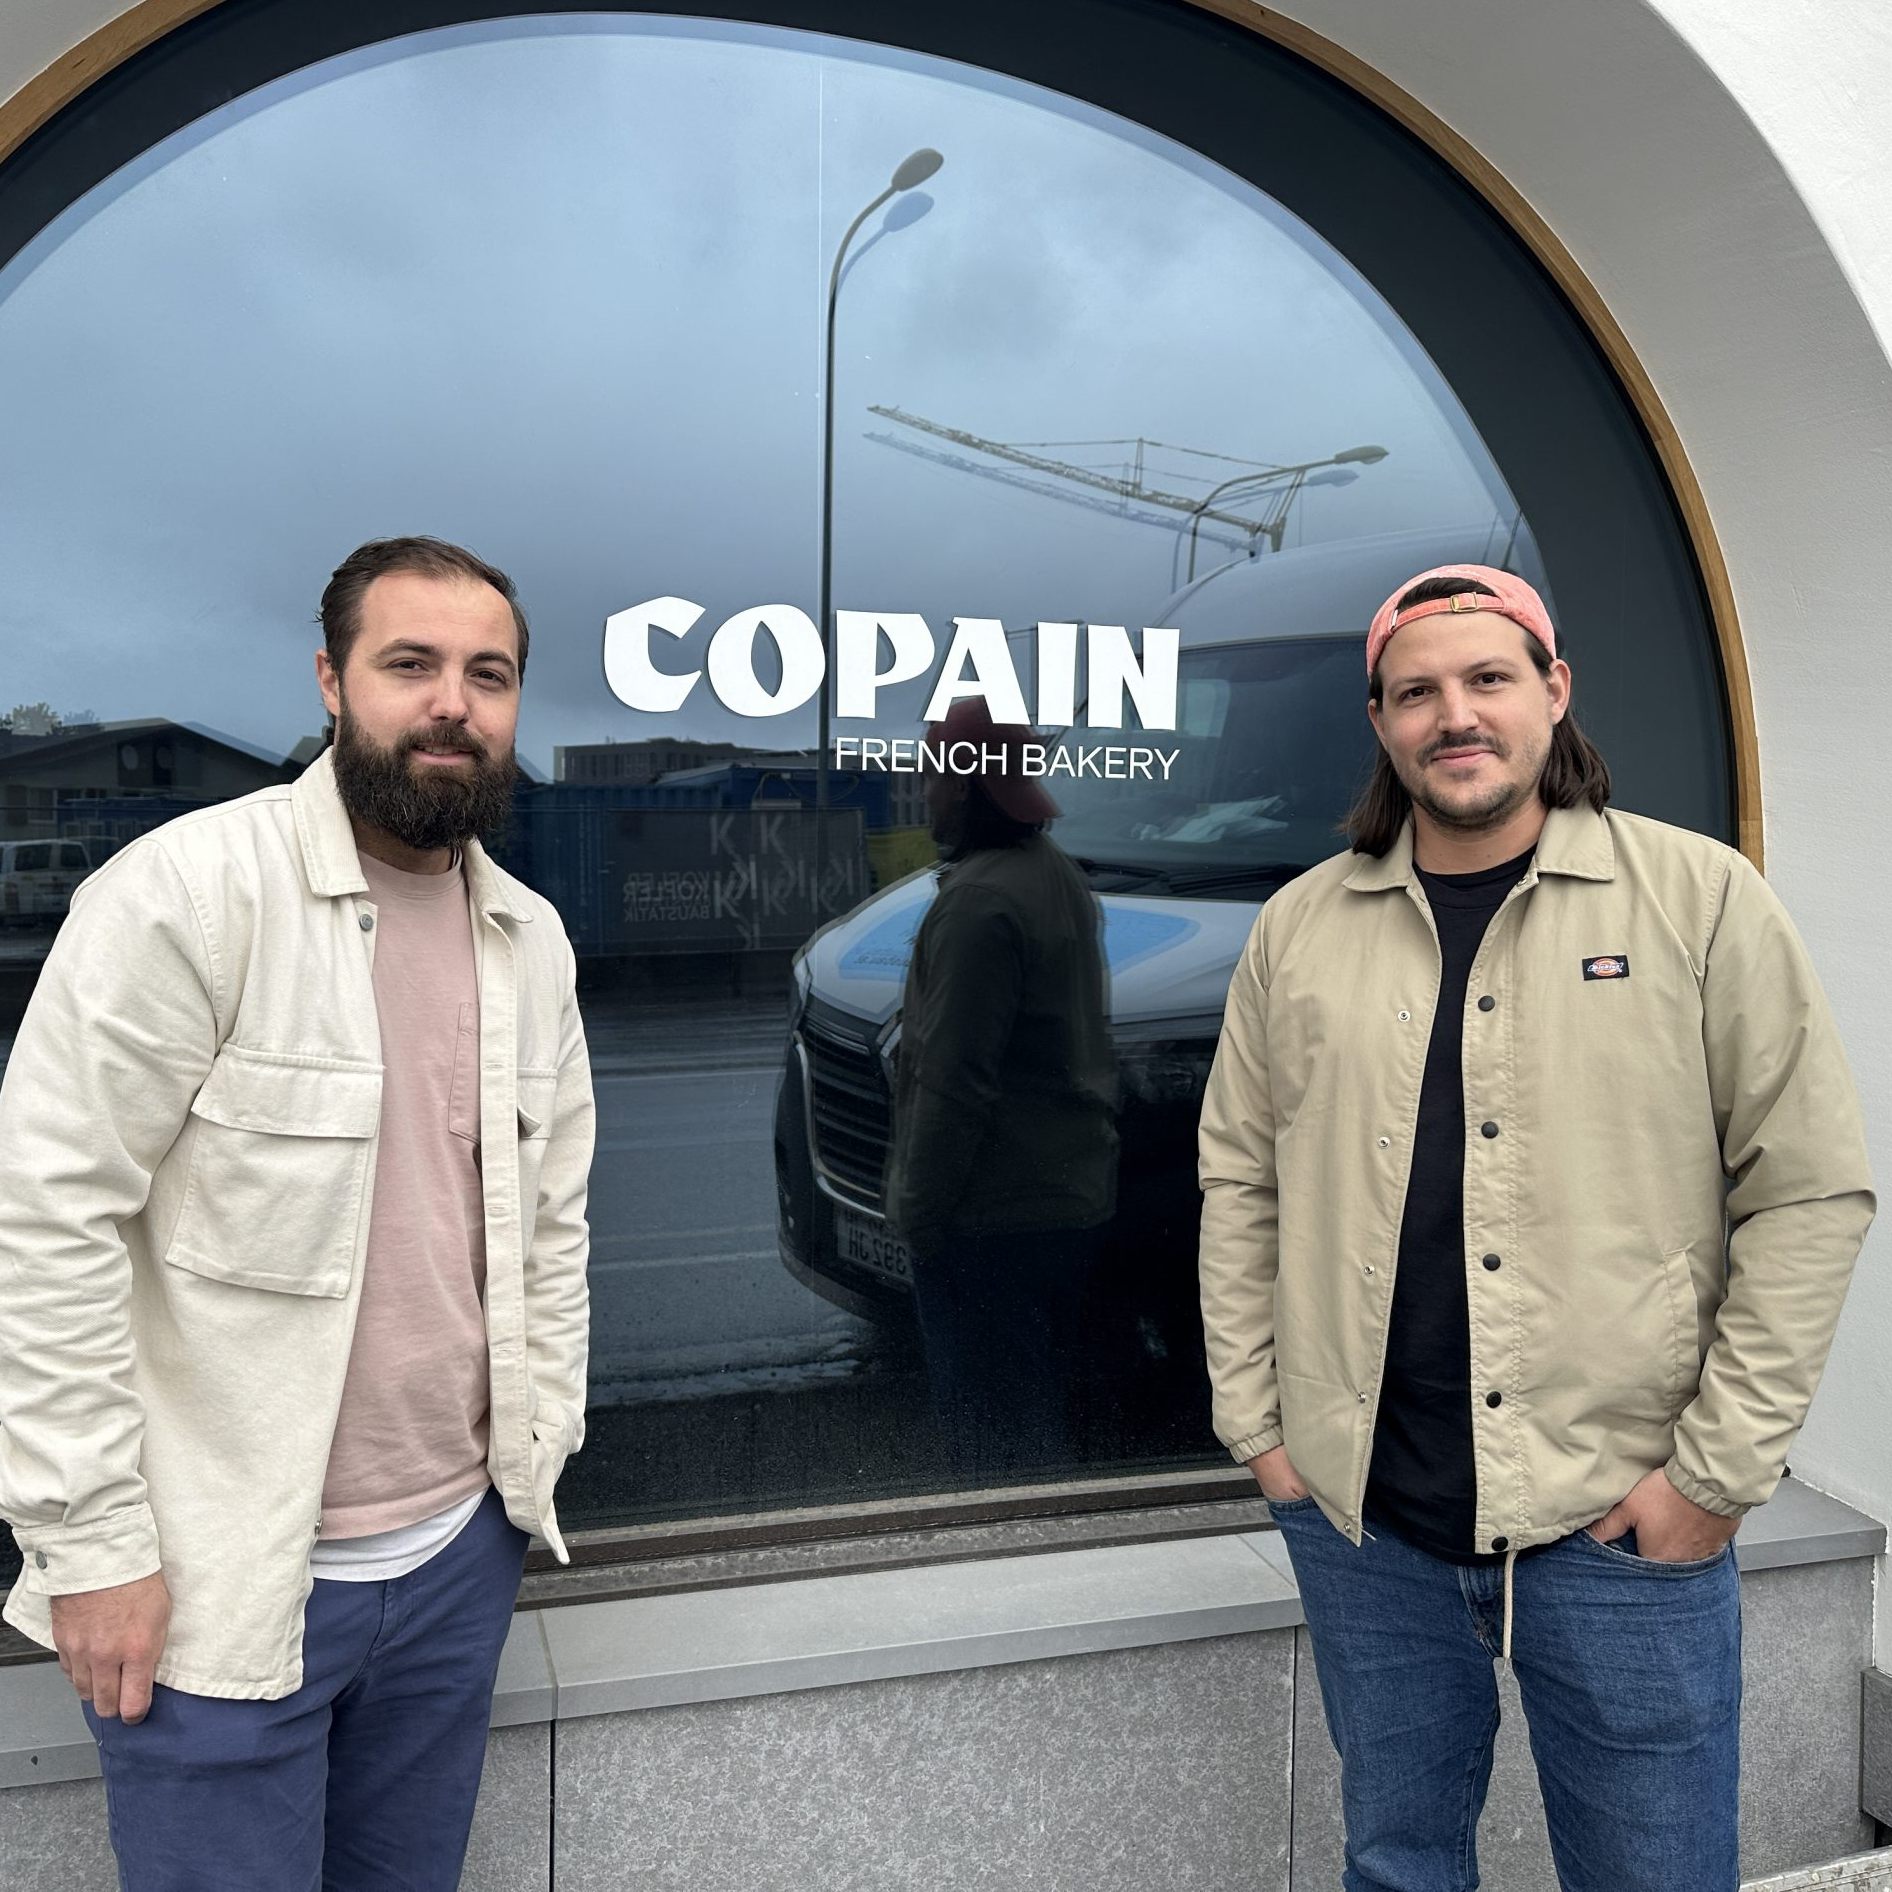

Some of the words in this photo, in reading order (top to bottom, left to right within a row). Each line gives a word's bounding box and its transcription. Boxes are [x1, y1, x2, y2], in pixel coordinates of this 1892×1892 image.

[605, 597, 1179, 730] COPAIN
[837, 737, 1006, 775] FRENCH
[1023, 744, 1179, 779] BAKERY
